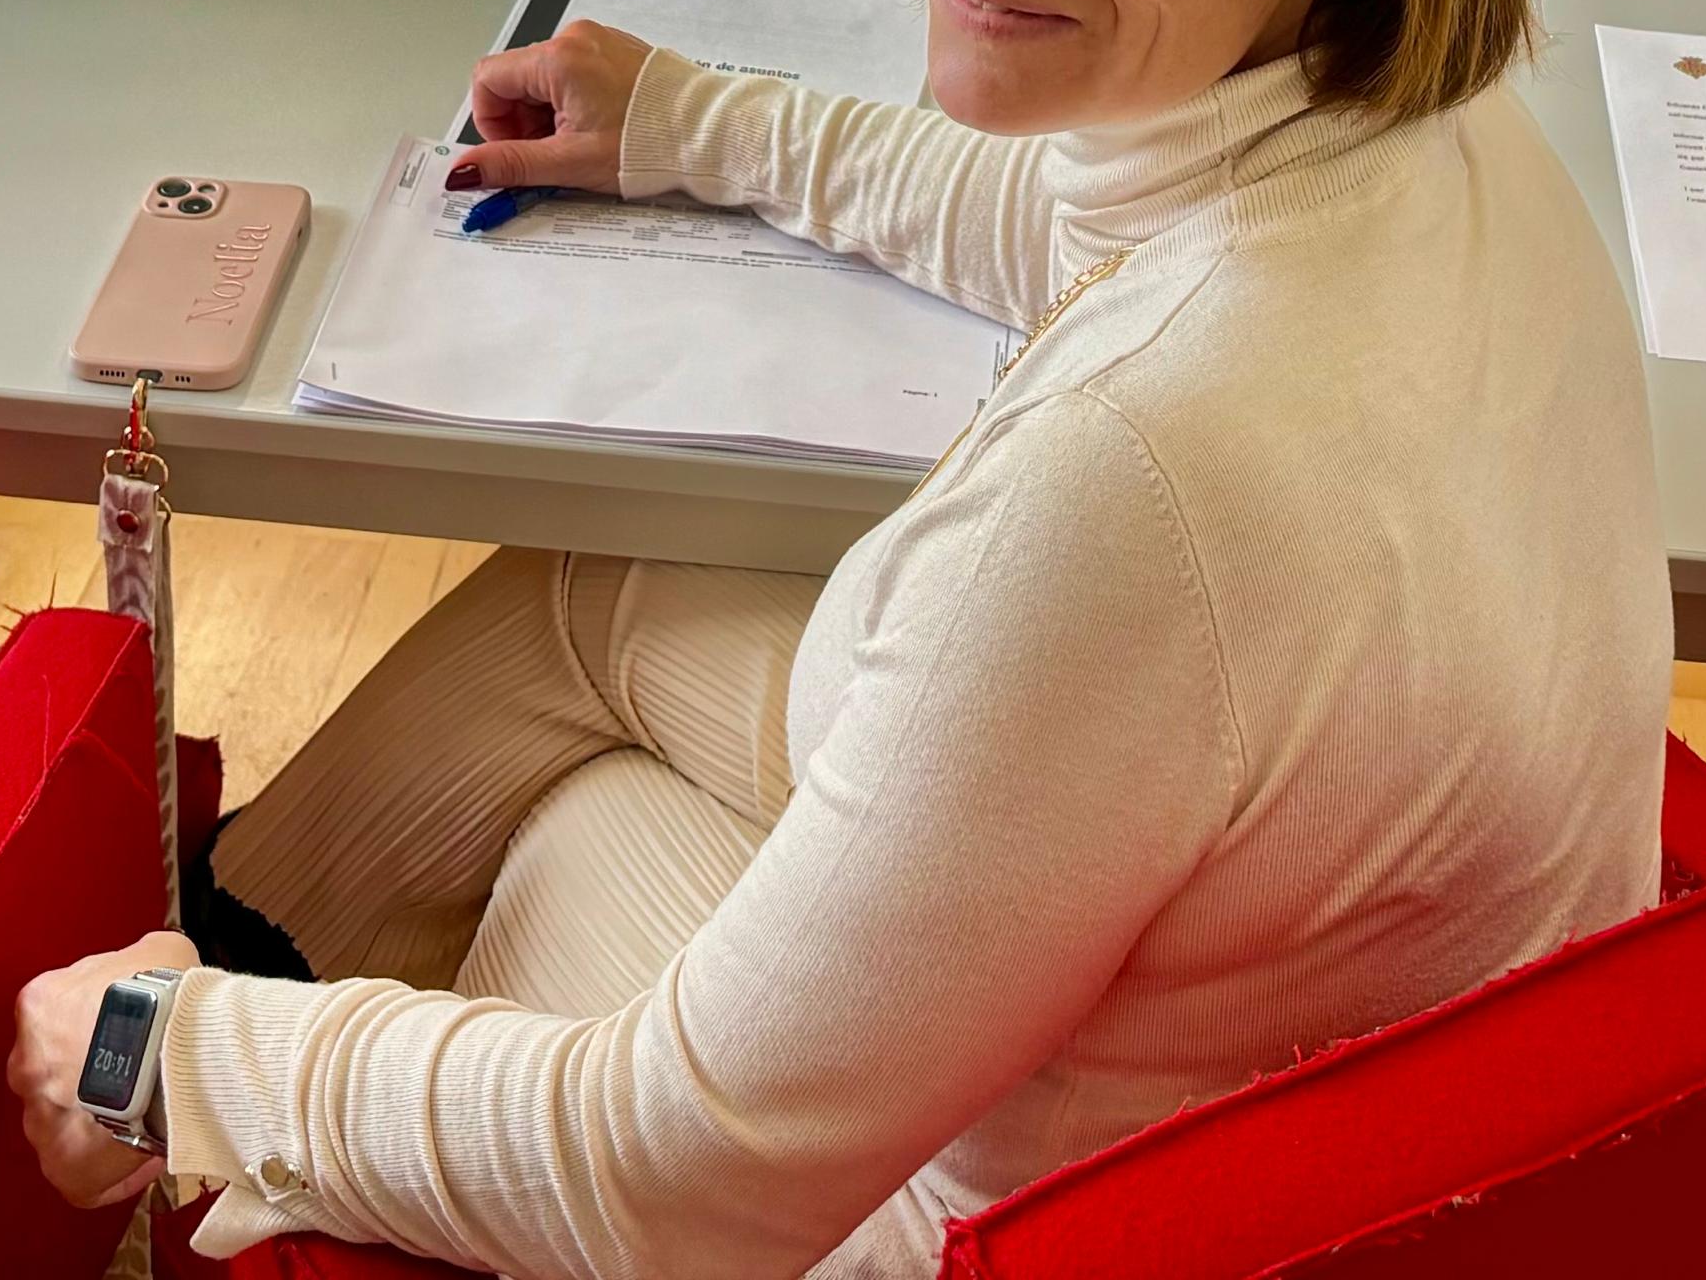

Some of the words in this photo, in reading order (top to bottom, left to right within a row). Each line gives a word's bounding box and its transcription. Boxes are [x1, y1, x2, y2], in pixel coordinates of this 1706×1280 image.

[716, 61, 735, 72] de
[739, 65, 801, 80] asuntos
[185, 223, 272, 326] Noelia
[94, 1048, 132, 1077] 14:02
